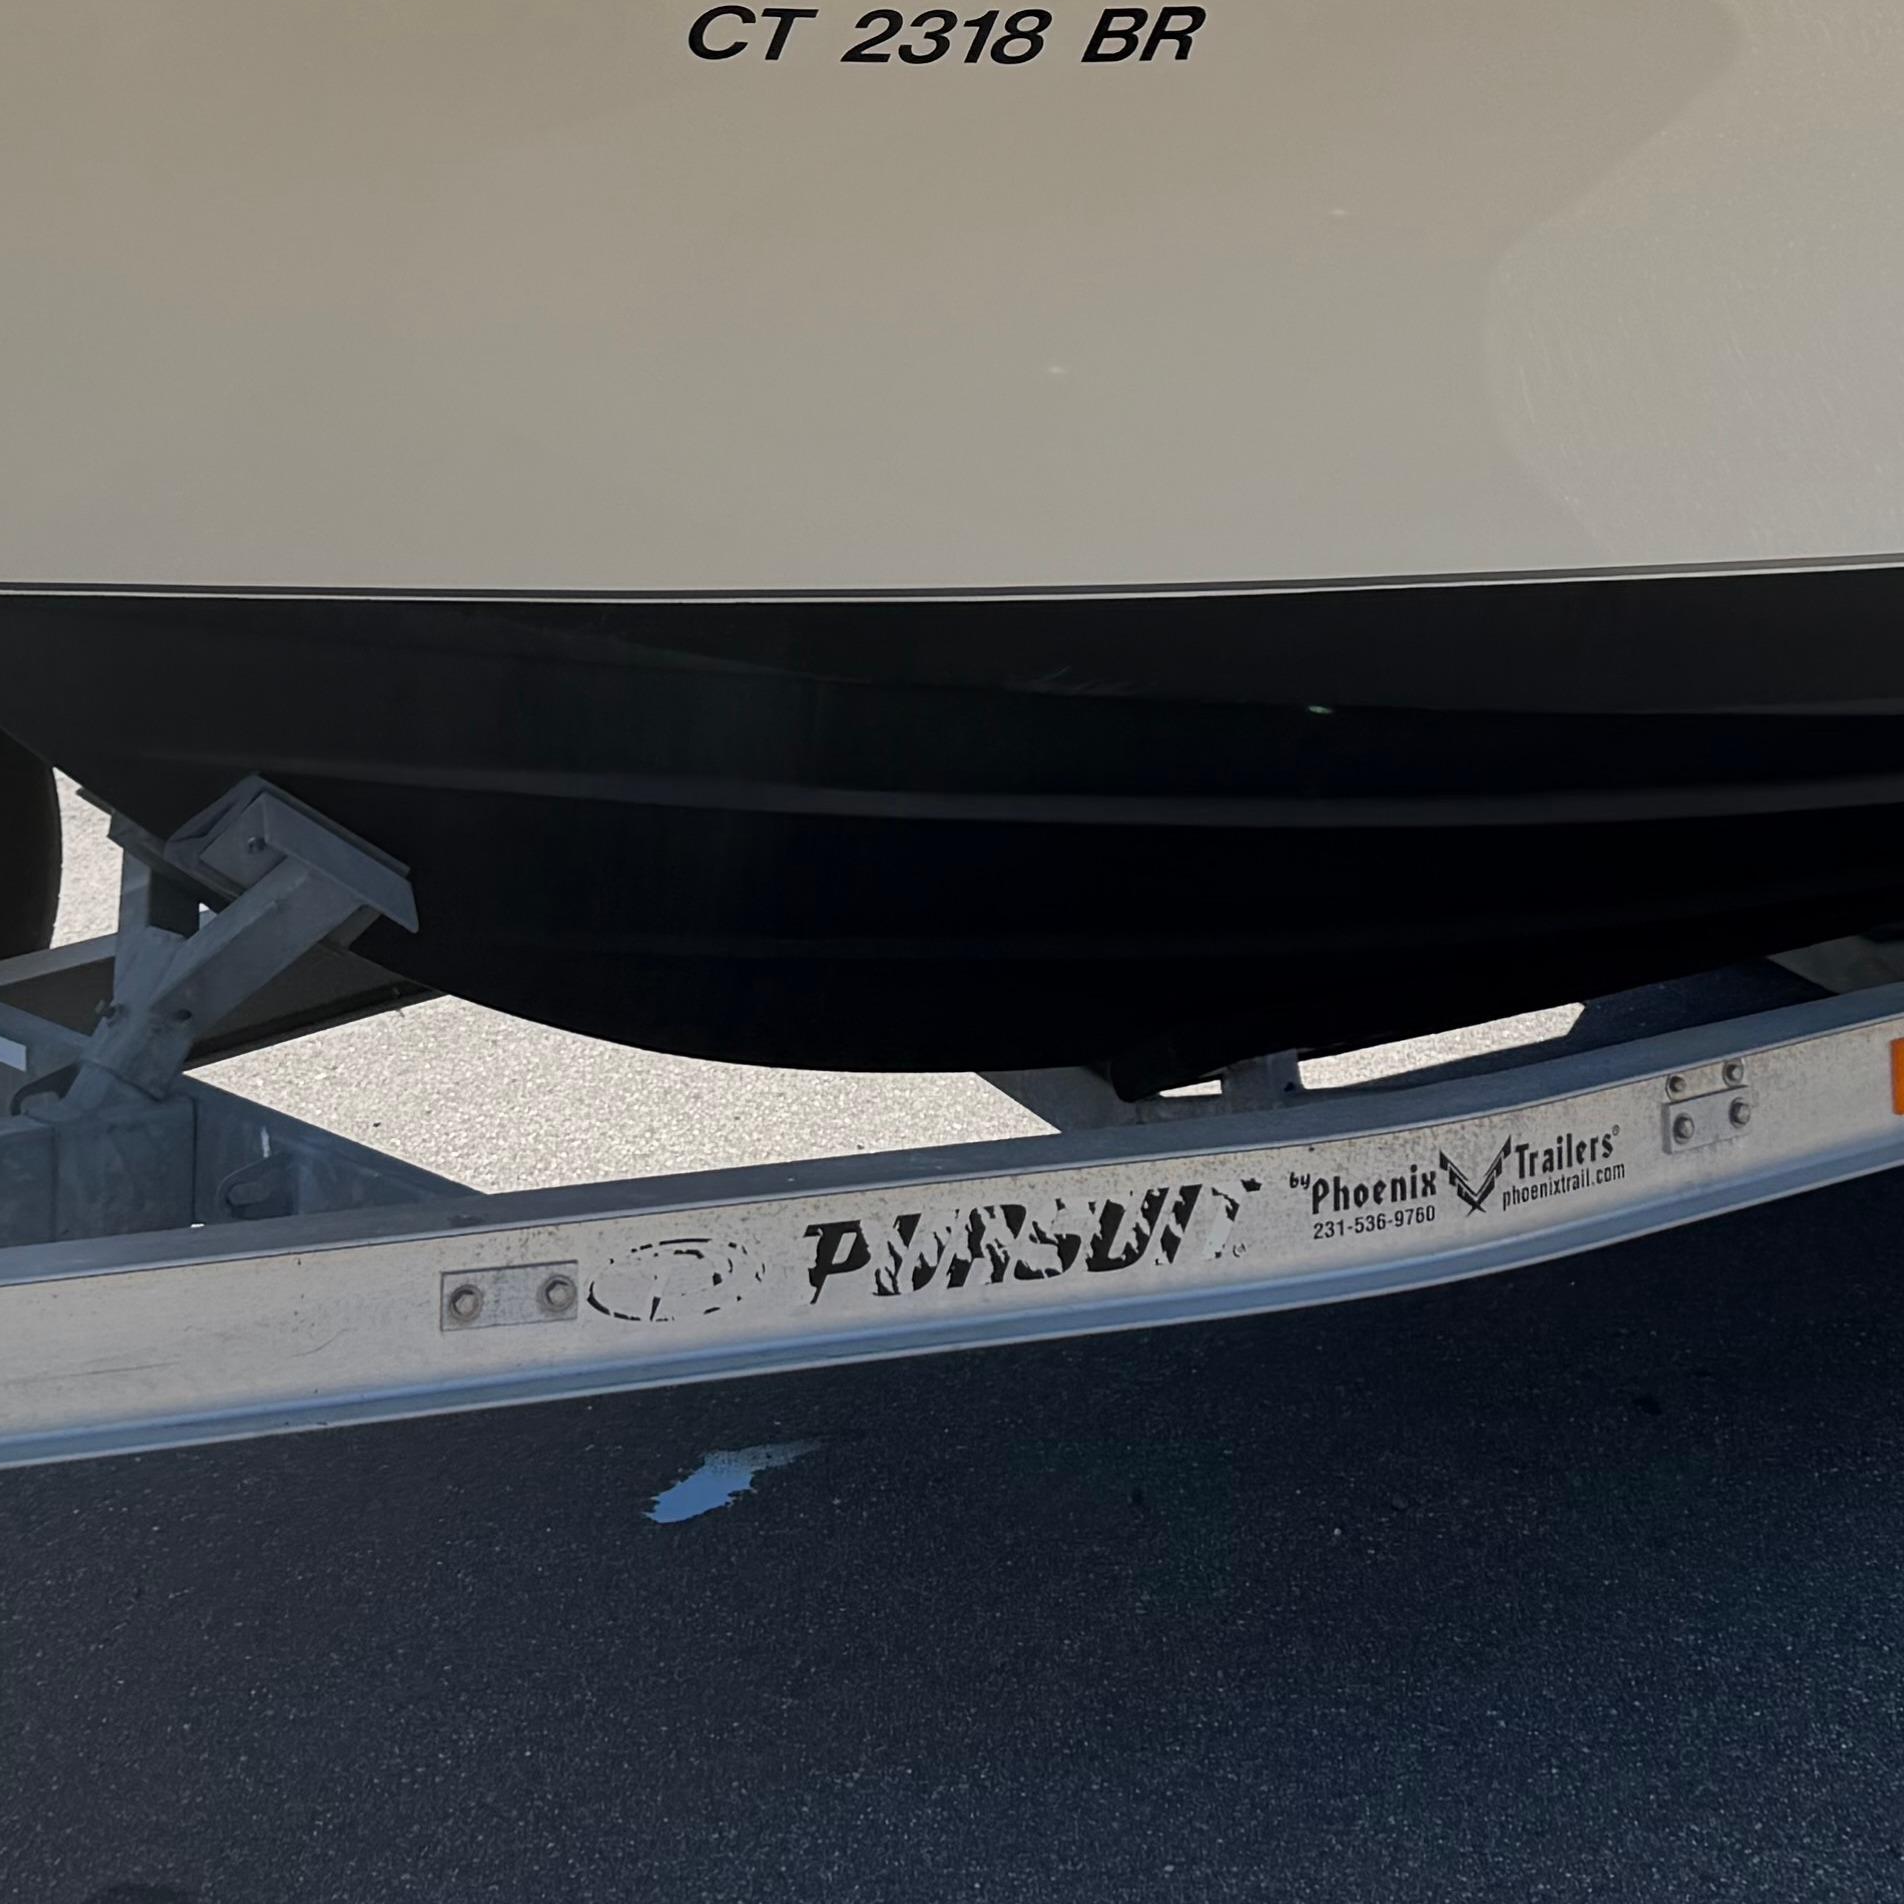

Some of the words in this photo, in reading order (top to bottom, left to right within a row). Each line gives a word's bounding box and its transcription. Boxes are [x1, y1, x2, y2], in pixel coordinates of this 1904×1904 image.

[686, 3, 819, 62] CT
[839, 8, 1053, 66] 2318
[1080, 5, 1207, 64] BR
[1289, 1171, 1312, 1190] by
[1311, 1163, 1438, 1215] Phoenix
[1515, 1130, 1615, 1180] Trailers
[1501, 1162, 1626, 1212] phoenixtrail.com
[1312, 1204, 1437, 1241] 231-536-9760
